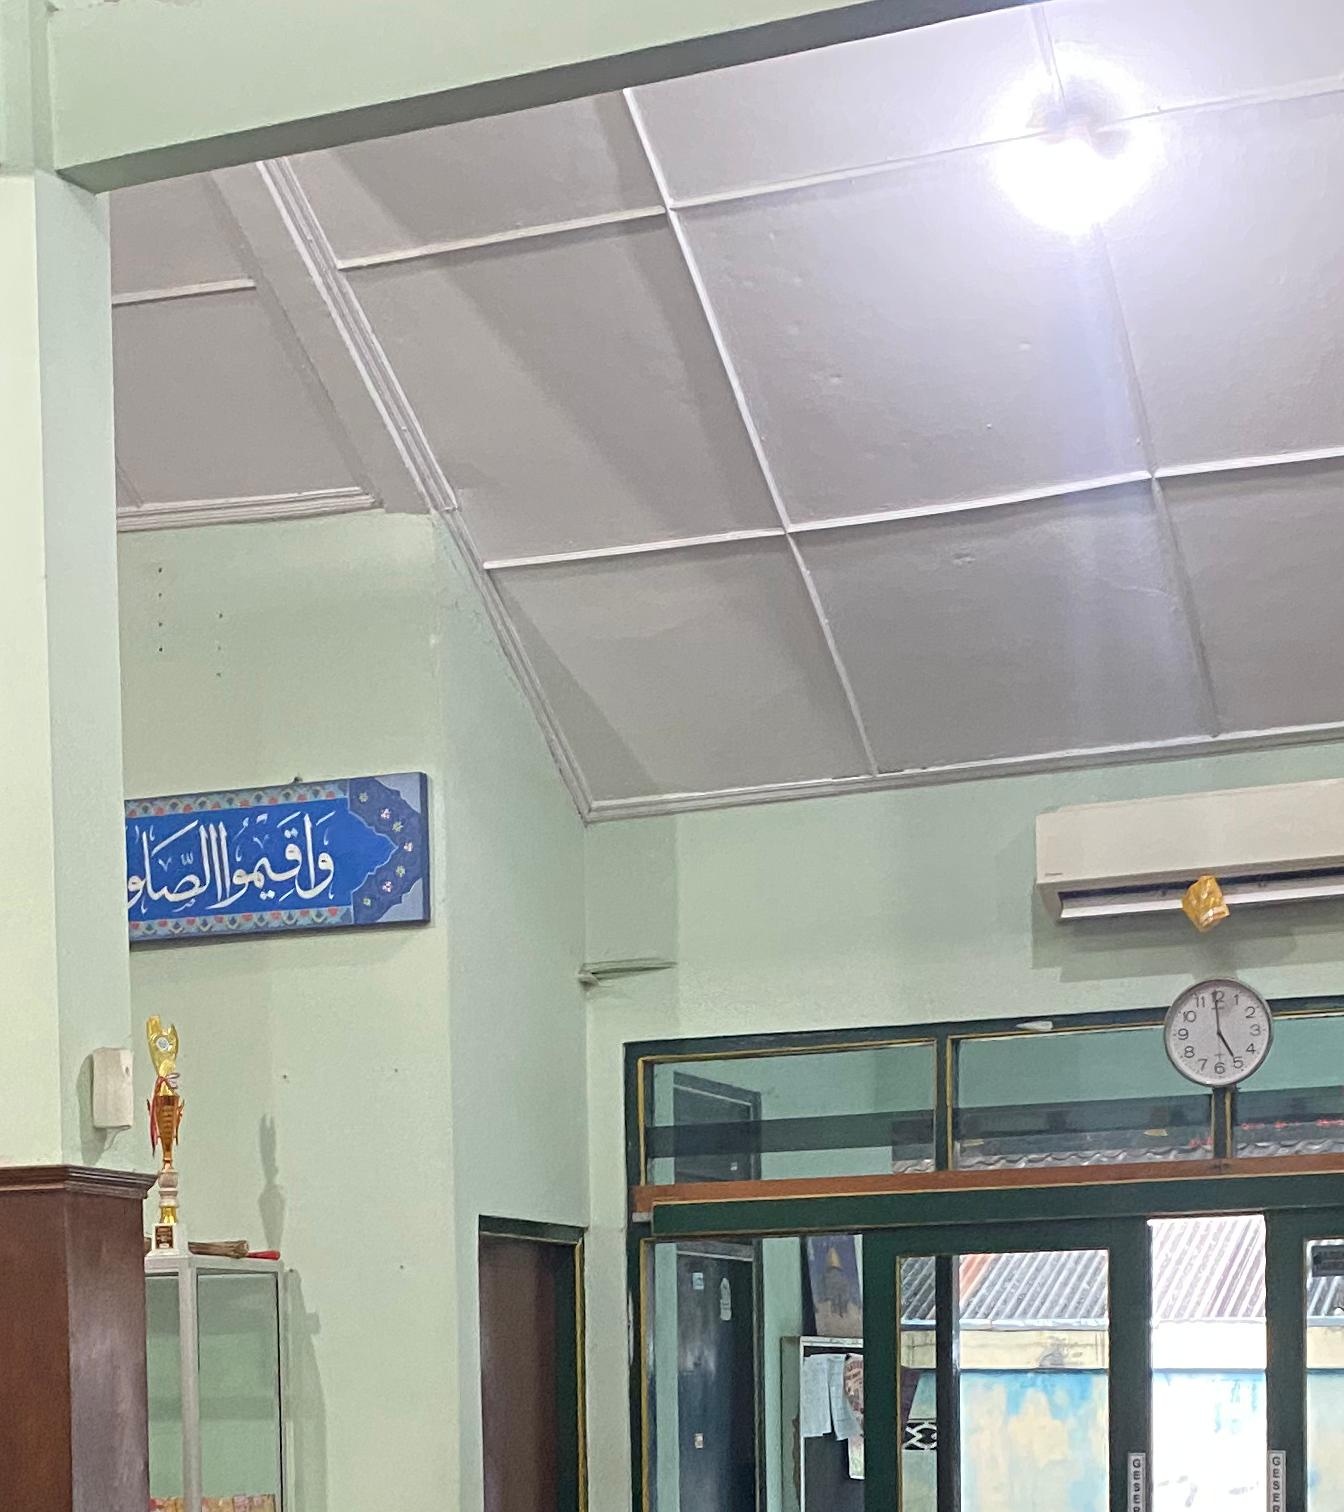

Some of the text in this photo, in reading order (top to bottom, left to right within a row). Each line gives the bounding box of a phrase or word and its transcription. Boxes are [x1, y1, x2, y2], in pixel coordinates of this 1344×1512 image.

[1196, 996, 1205, 1008] 11
[1233, 994, 1239, 1005] 1
[1184, 1010, 1196, 1022] 10
[1245, 1006, 1256, 1019] 2
[1178, 1028, 1189, 1040] 9
[1250, 1024, 1260, 1036] 3
[1184, 1046, 1195, 1058] 8
[1246, 1043, 1256, 1054] 4
[1198, 1059, 1208, 1071] 7
[1214, 1062, 1225, 1074] 6
[1233, 1056, 1243, 1069] 5
